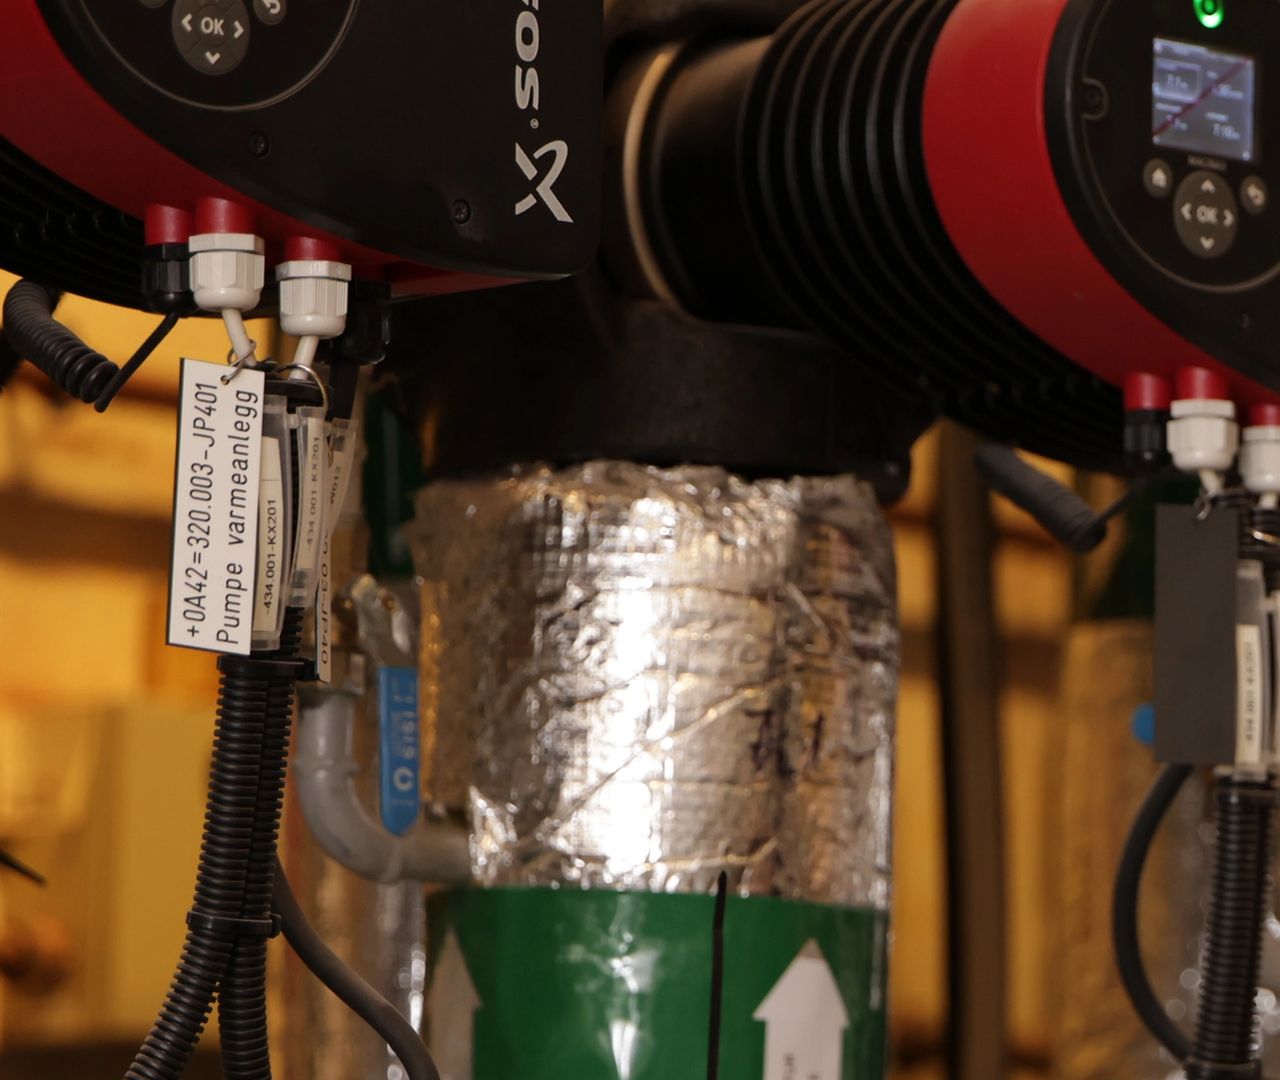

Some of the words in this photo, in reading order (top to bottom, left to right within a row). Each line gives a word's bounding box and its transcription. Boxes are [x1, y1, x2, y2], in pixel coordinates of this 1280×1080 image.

[201, 17, 224, 35] OK
[515, 0, 539, 110] OS
[1197, 206, 1218, 223] OK
[227, 389, 259, 547] varmeanlegg
[216, 562, 248, 645] Pumpe
